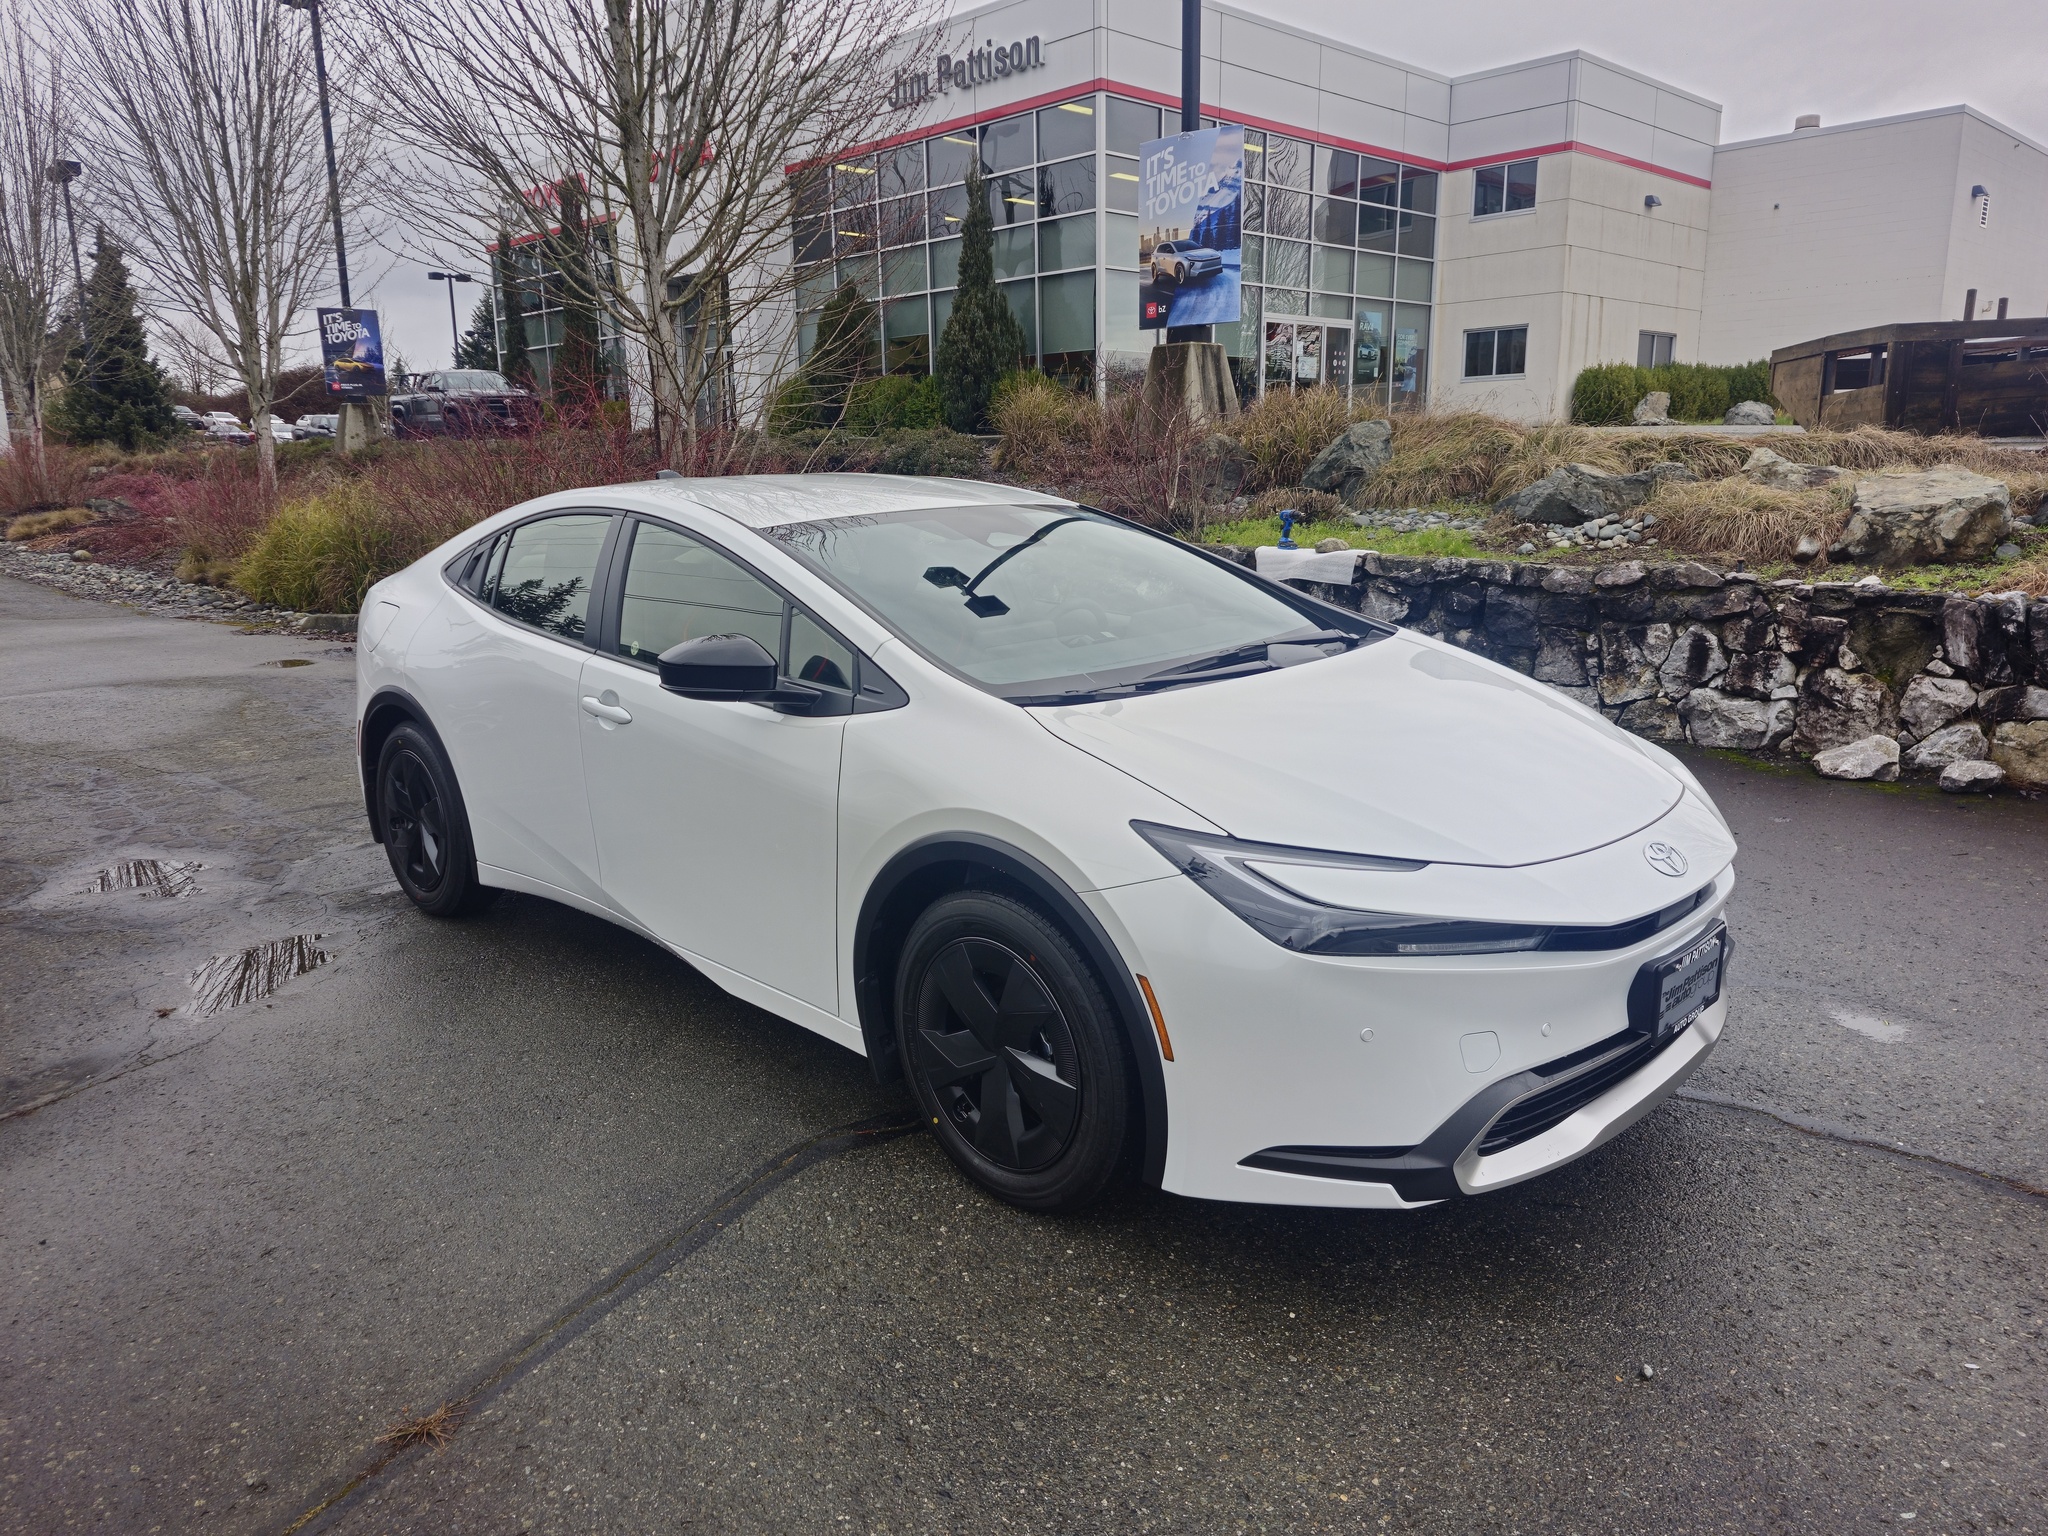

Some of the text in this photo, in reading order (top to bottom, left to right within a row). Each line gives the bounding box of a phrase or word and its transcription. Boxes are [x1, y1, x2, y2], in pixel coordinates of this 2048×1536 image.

[887, 34, 1042, 108] Jim Pattison
[1145, 146, 1175, 179] IT'S
[1146, 161, 1206, 198] TIME TO
[1145, 172, 1220, 220] TOYOTA
[323, 312, 342, 325] IT'S
[1158, 304, 1167, 314] bZ
[325, 320, 362, 333] TIME TO
[325, 328, 370, 344] TOYOTA
[1682, 936, 1717, 967] JIM PATTISON
[1665, 983, 1684, 1003] Jim
[1683, 957, 1718, 989] Pattison
[1673, 1004, 1705, 1034] AUTO GROUP
